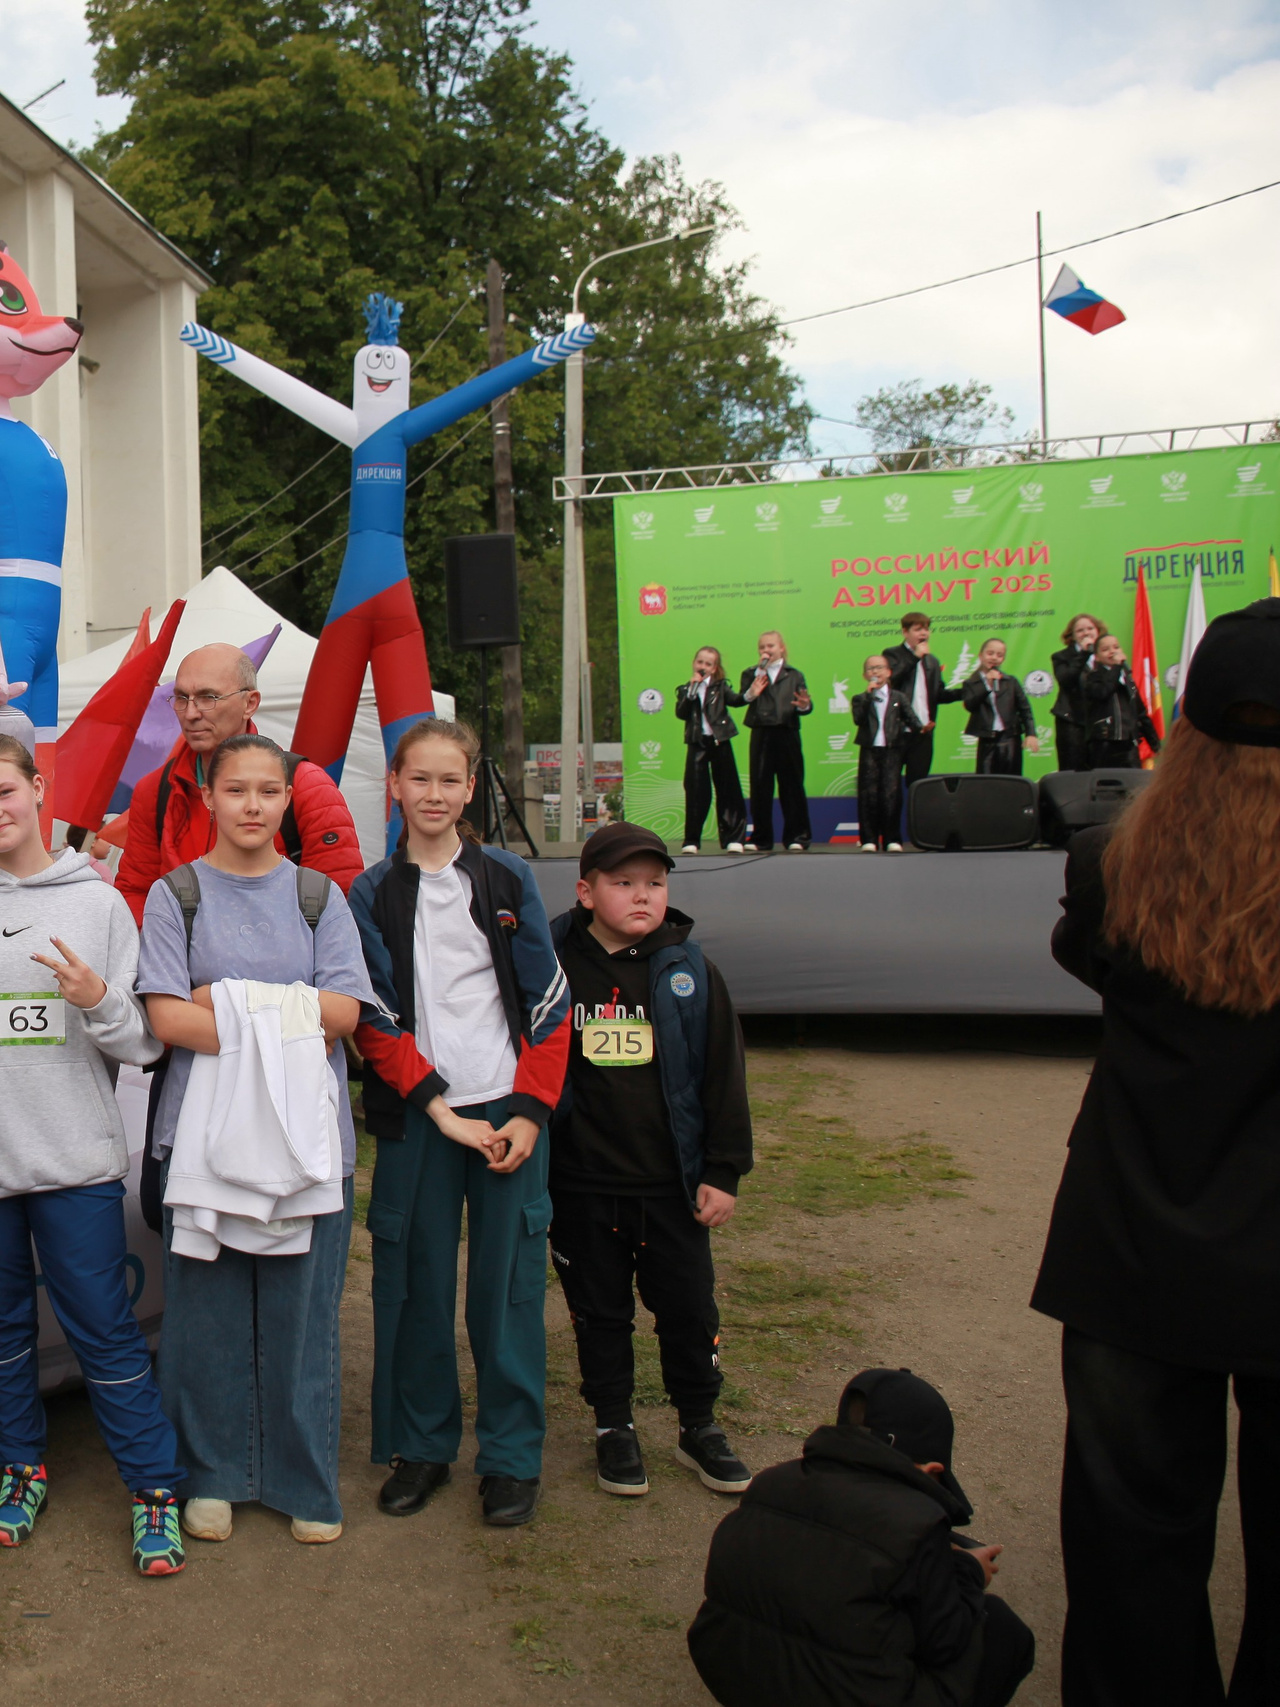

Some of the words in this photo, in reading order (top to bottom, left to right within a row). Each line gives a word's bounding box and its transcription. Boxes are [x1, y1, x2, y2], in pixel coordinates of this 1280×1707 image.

[356, 467, 402, 480] ДИРЕКЦИЯ
[831, 541, 1050, 578] РОССИЙСКИЙ
[832, 578, 977, 609] АЗИМУТ
[990, 574, 1053, 594] 2025
[9, 1005, 49, 1032] 63
[592, 1030, 643, 1055] 215
